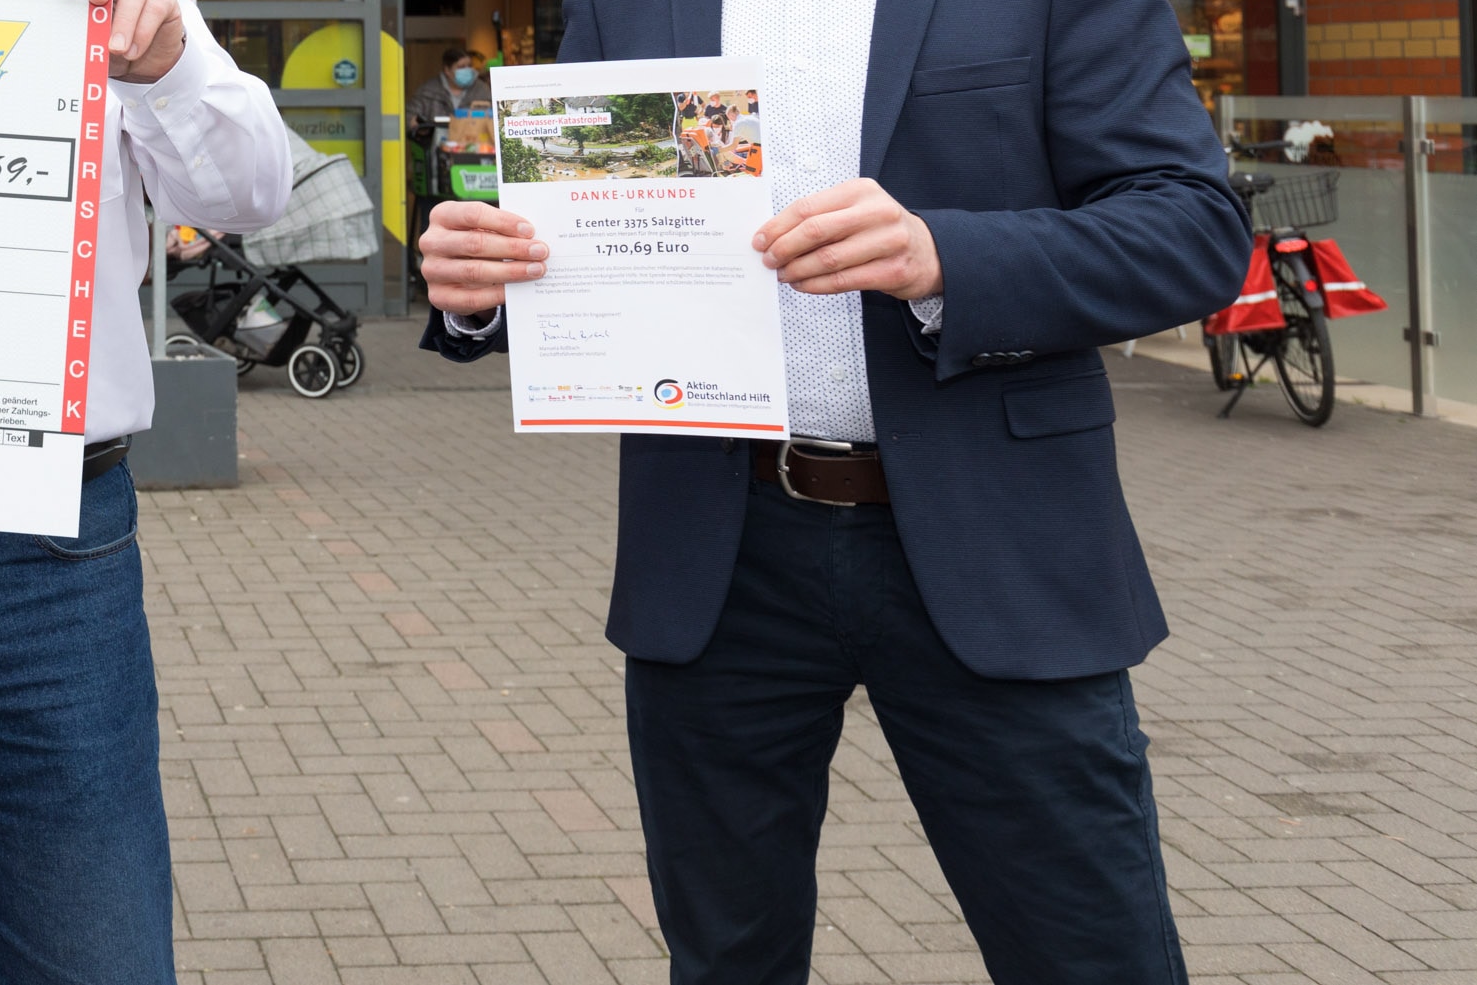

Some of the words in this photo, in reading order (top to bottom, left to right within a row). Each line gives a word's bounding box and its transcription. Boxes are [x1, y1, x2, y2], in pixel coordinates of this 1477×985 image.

[507, 114, 608, 128] Hochwasser-Katastrophe
[290, 120, 346, 135] erzlich
[508, 126, 558, 137] Deutschland
[571, 188, 696, 201] DANKE-URKUNDE
[576, 219, 582, 228] E
[585, 218, 621, 228] center
[624, 218, 648, 229] 3375
[651, 216, 706, 229] Salzgitter
[595, 241, 652, 256] 1.710,69
[657, 241, 690, 253] Euro
[686, 381, 718, 390] Aktion
[2, 396, 38, 406] geändert
[687, 391, 747, 401] Deutschland
[749, 393, 771, 403] Hilft
[11, 407, 51, 418] Zahlungs-
[6, 433, 26, 443] Text
